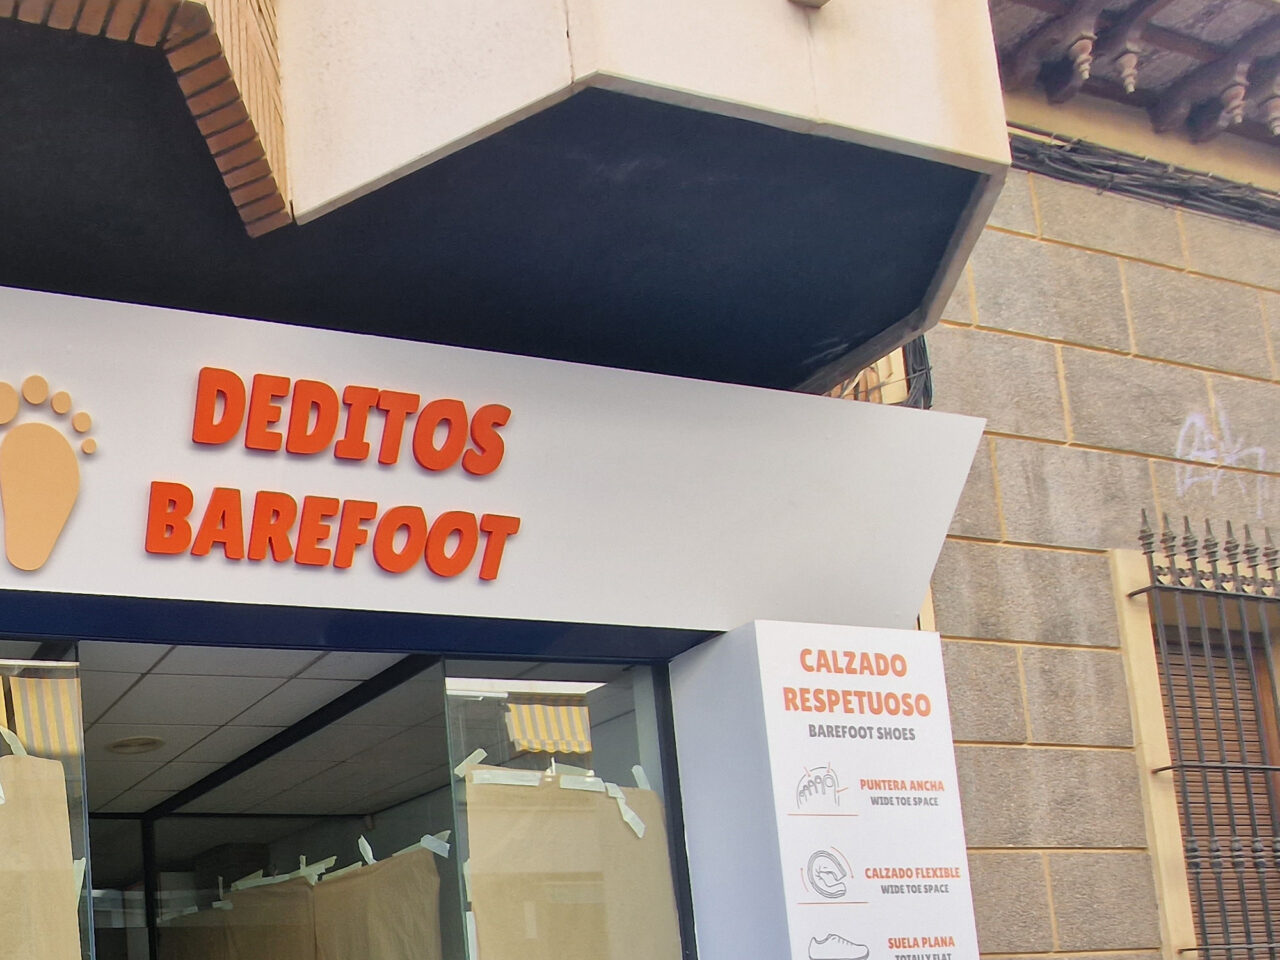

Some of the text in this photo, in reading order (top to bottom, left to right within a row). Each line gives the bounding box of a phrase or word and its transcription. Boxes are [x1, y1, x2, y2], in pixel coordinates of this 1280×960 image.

[191, 366, 512, 476] DEDITOS
[145, 480, 521, 581] BAREFOOT
[799, 648, 908, 678] CALZADO
[783, 686, 932, 717] RESPETUOSO
[808, 724, 916, 741] BAREFOOT SHOES
[860, 778, 945, 792] PUNTERA ANCHA
[870, 796, 939, 806] WIDE TOE SPACE
[864, 867, 961, 880] CALZADO FLEXIBLE
[881, 884, 950, 894] WIDE TOE SPACE
[888, 936, 955, 949] SUELA PLANA
